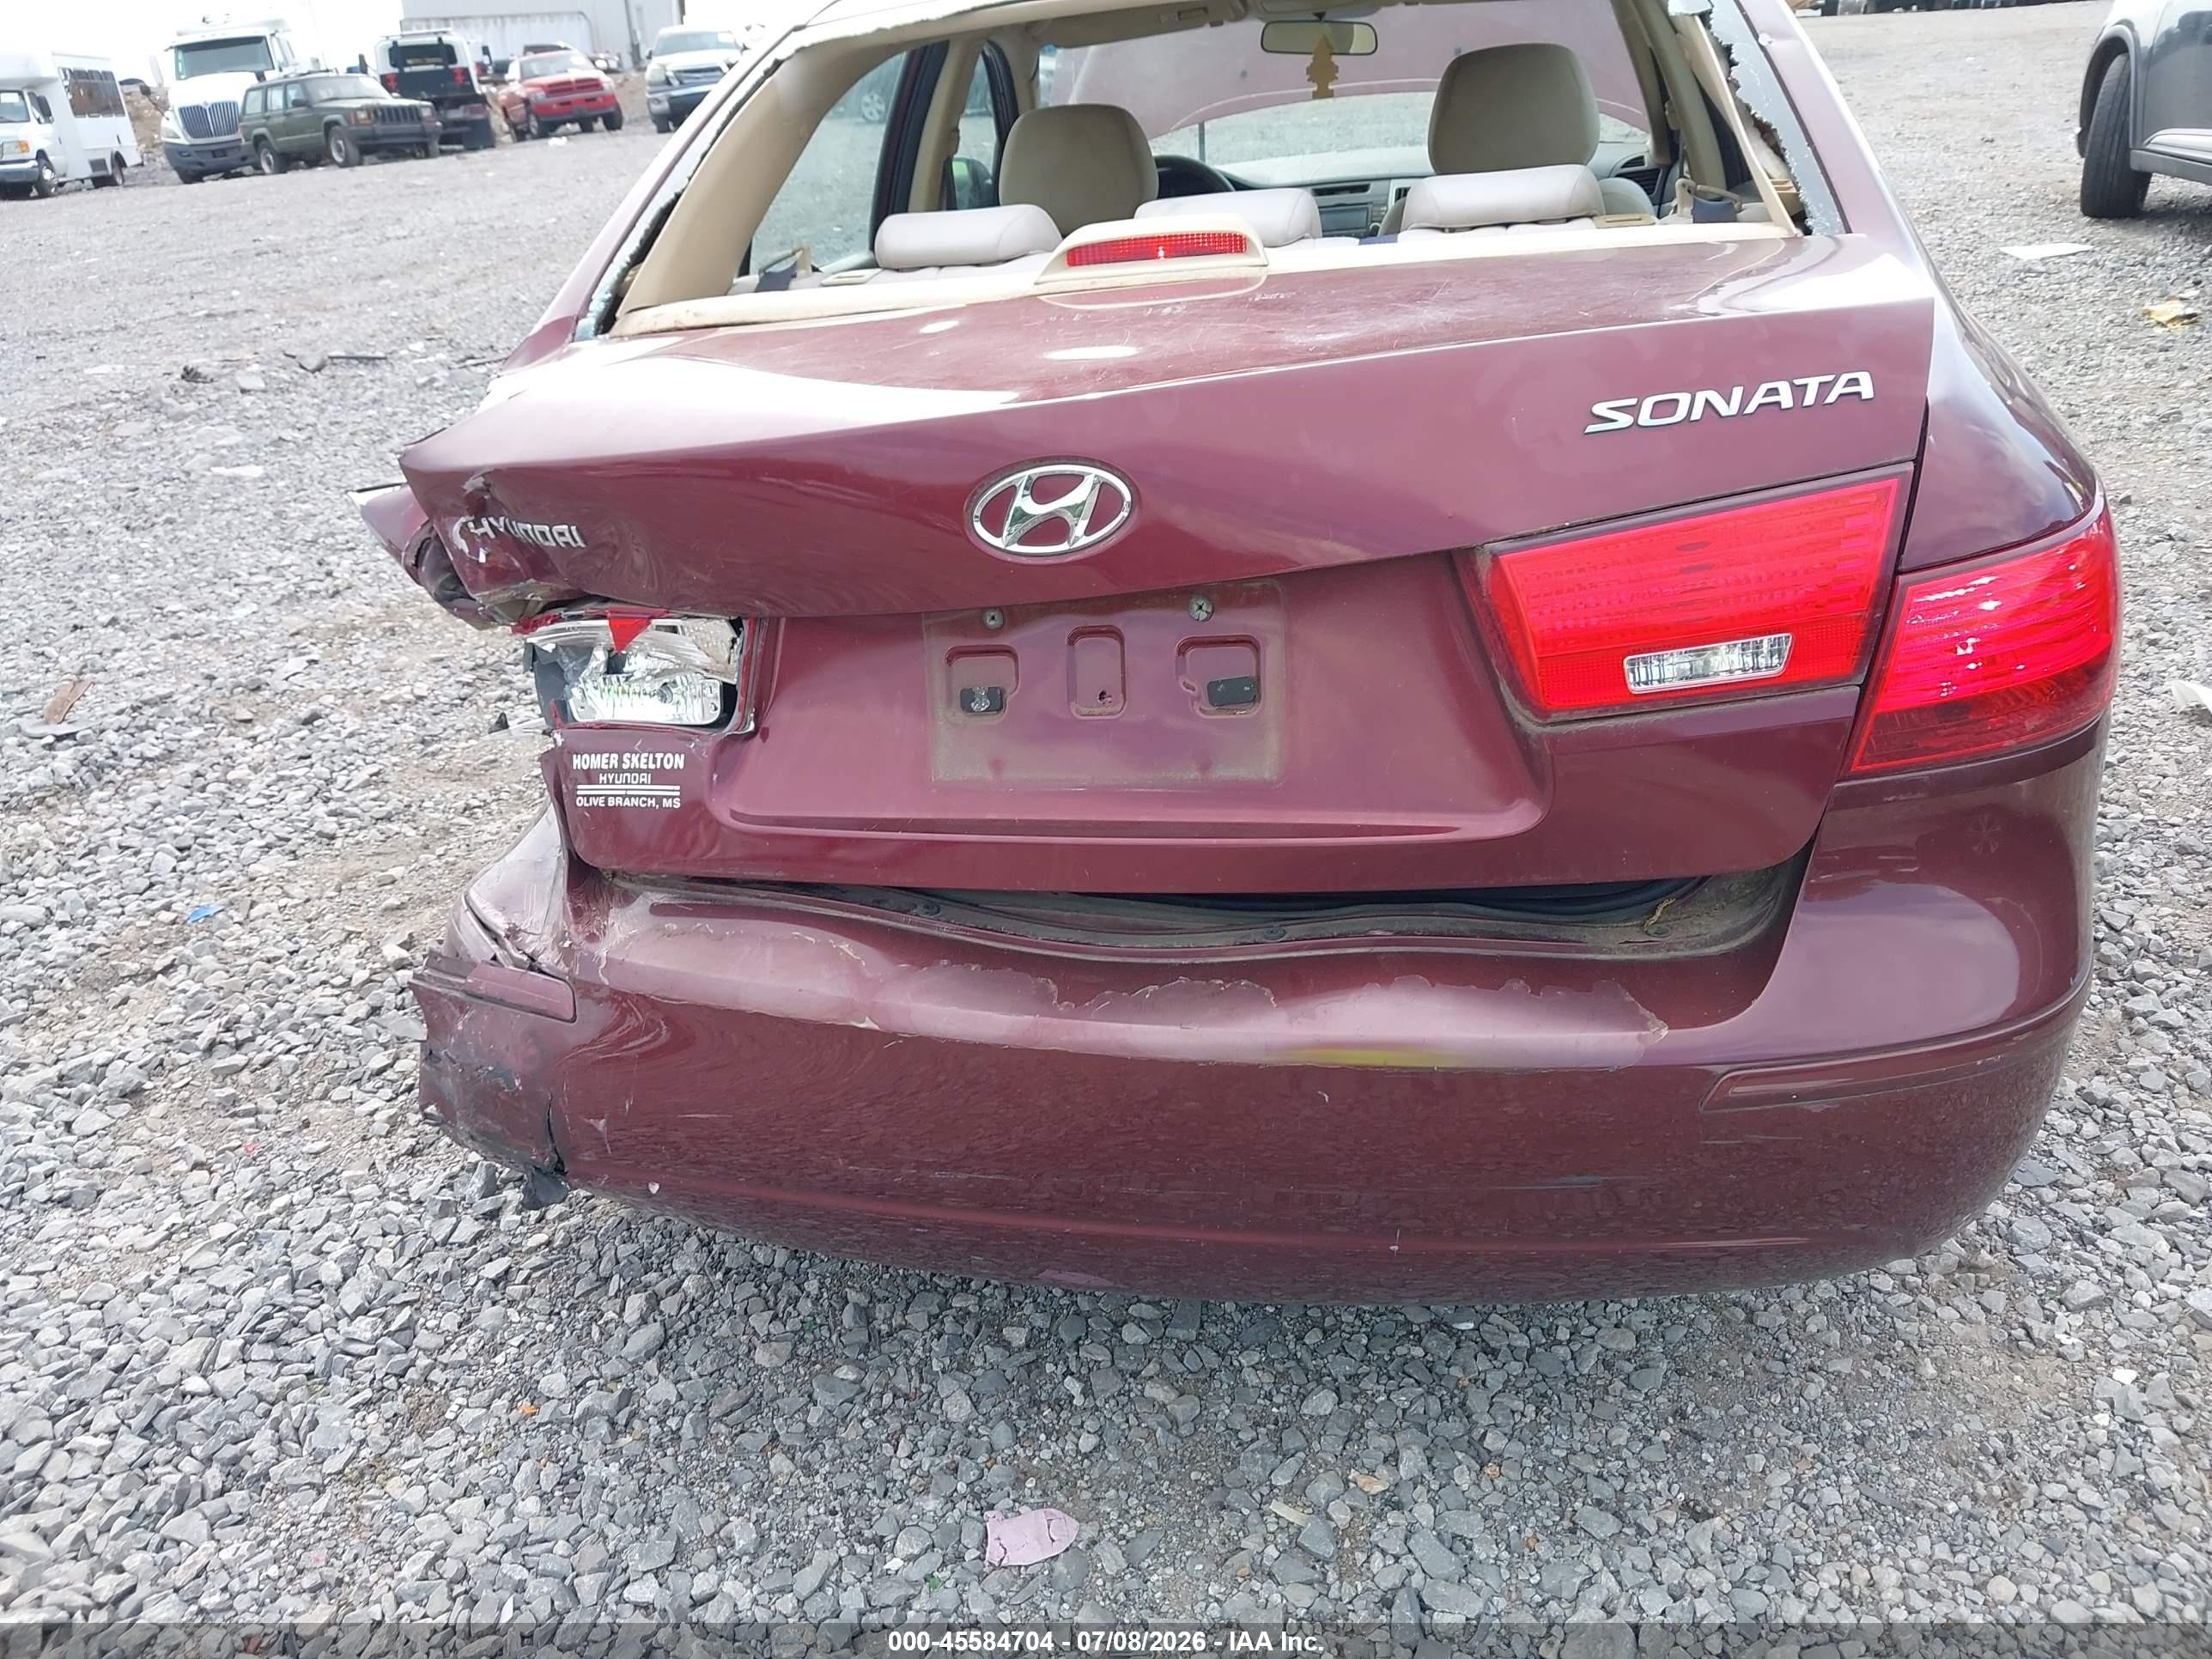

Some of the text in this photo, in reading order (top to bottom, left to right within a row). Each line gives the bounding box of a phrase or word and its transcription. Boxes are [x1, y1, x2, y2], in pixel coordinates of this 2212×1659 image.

[1583, 370, 1875, 434] SONATA
[466, 515, 587, 549] HYUNDAI
[572, 752, 685, 770] HOMER SKELTON
[599, 772, 652, 785] HYUNDAI
[575, 796, 681, 810] OLIVE BRANCH, MS
